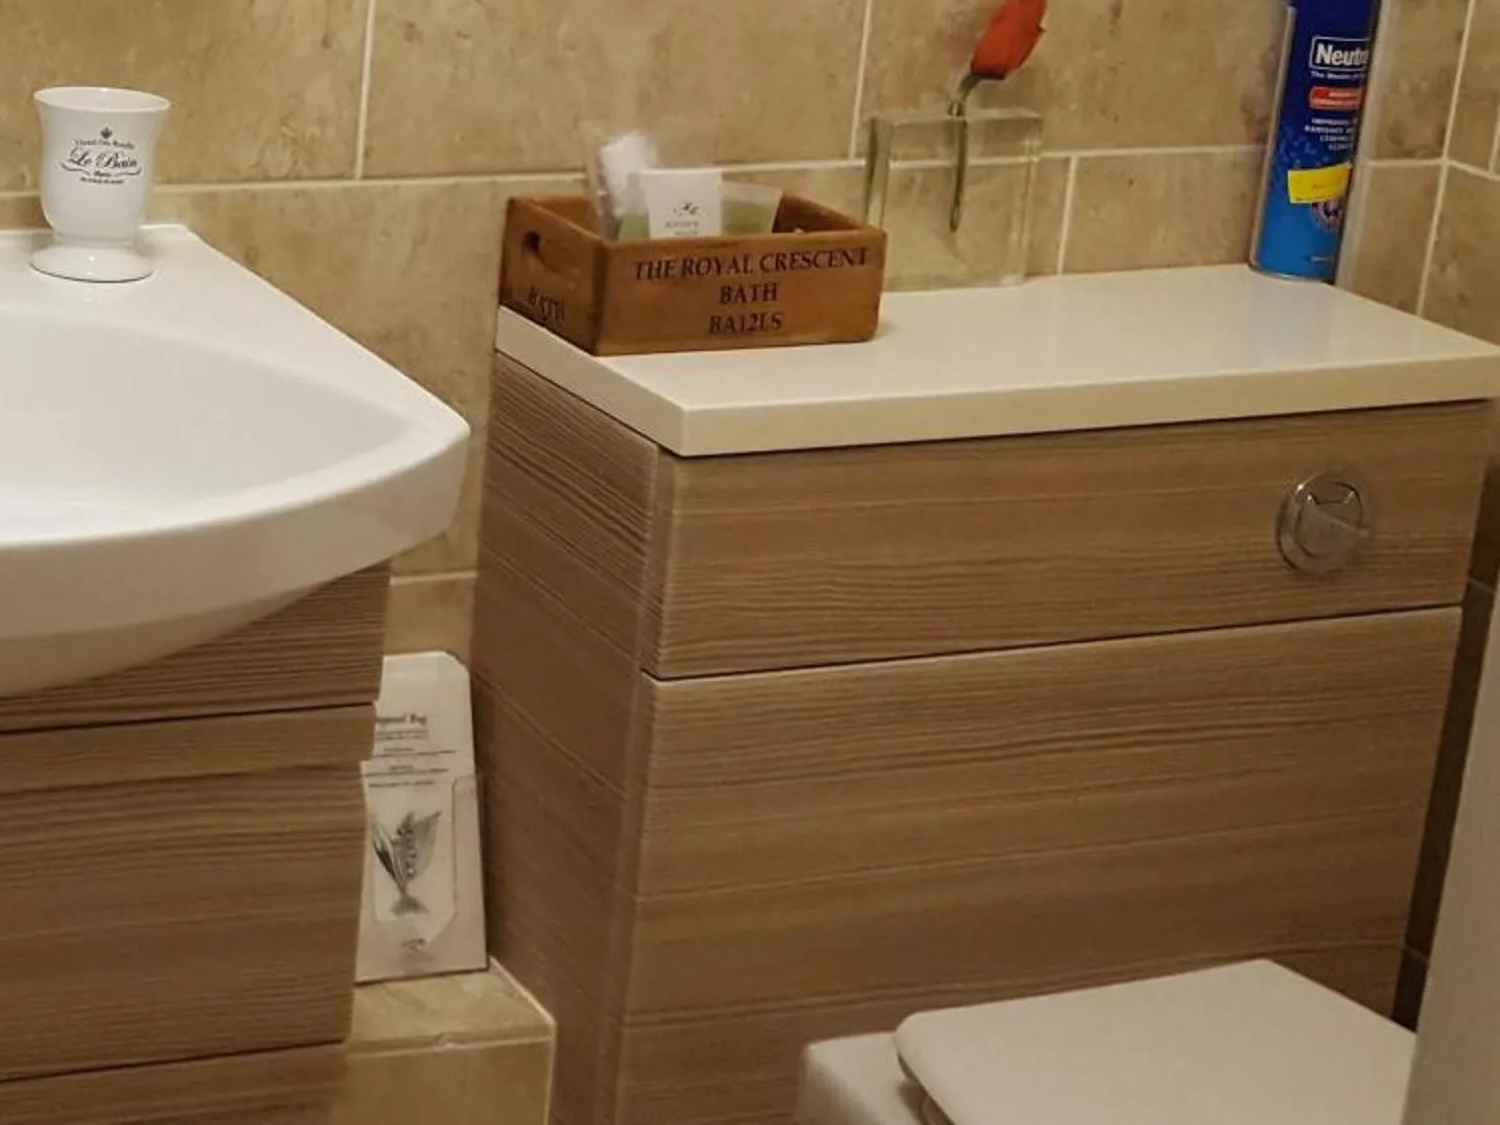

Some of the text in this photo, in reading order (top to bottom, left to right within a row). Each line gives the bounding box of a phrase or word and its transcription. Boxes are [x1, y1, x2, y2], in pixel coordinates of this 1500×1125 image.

[68, 146, 138, 169] Le Bain
[634, 246, 869, 281] THE ROYAL CRESCENT
[718, 282, 778, 306] BATH
